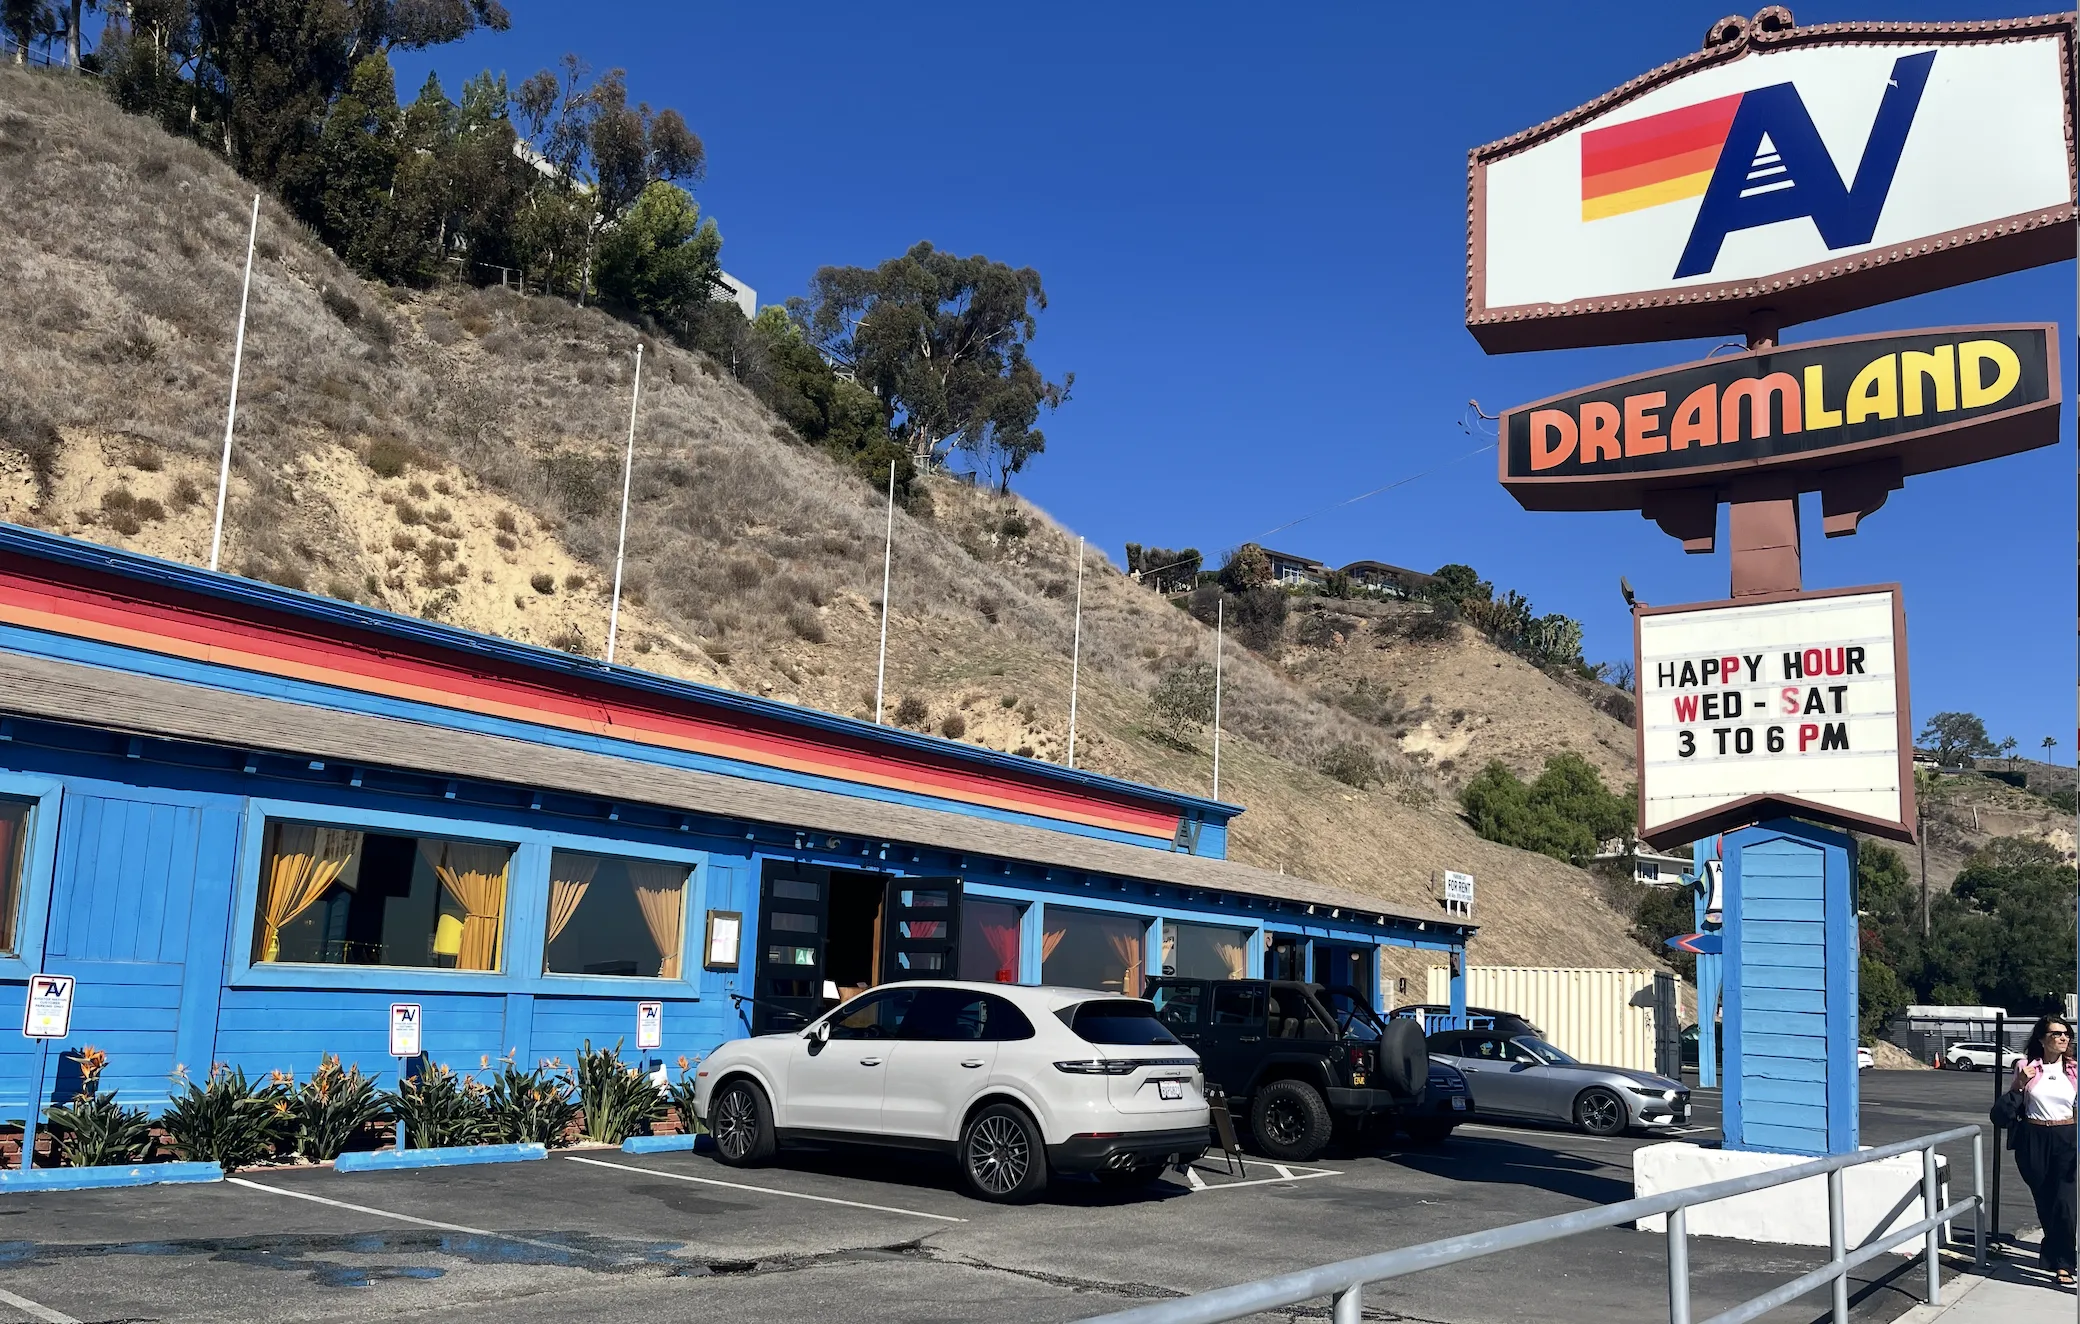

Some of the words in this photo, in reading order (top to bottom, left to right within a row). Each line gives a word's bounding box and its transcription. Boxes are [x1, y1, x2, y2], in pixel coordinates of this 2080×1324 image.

[1673, 49, 1938, 280] AV
[1530, 339, 2022, 471] DREAMLAND
[1658, 654, 1763, 688] HAPPY
[1783, 646, 1865, 680] HOUR
[1674, 691, 1742, 723] WED
[1781, 685, 1848, 715] SAT
[1678, 730, 1696, 758] 3
[1713, 727, 1754, 755] TO
[1766, 725, 1785, 753] 6
[1799, 722, 1850, 752] PM
[1448, 879, 1458, 891] FOR
[1458, 881, 1471, 894] RENT
[798, 950, 806, 962] A
